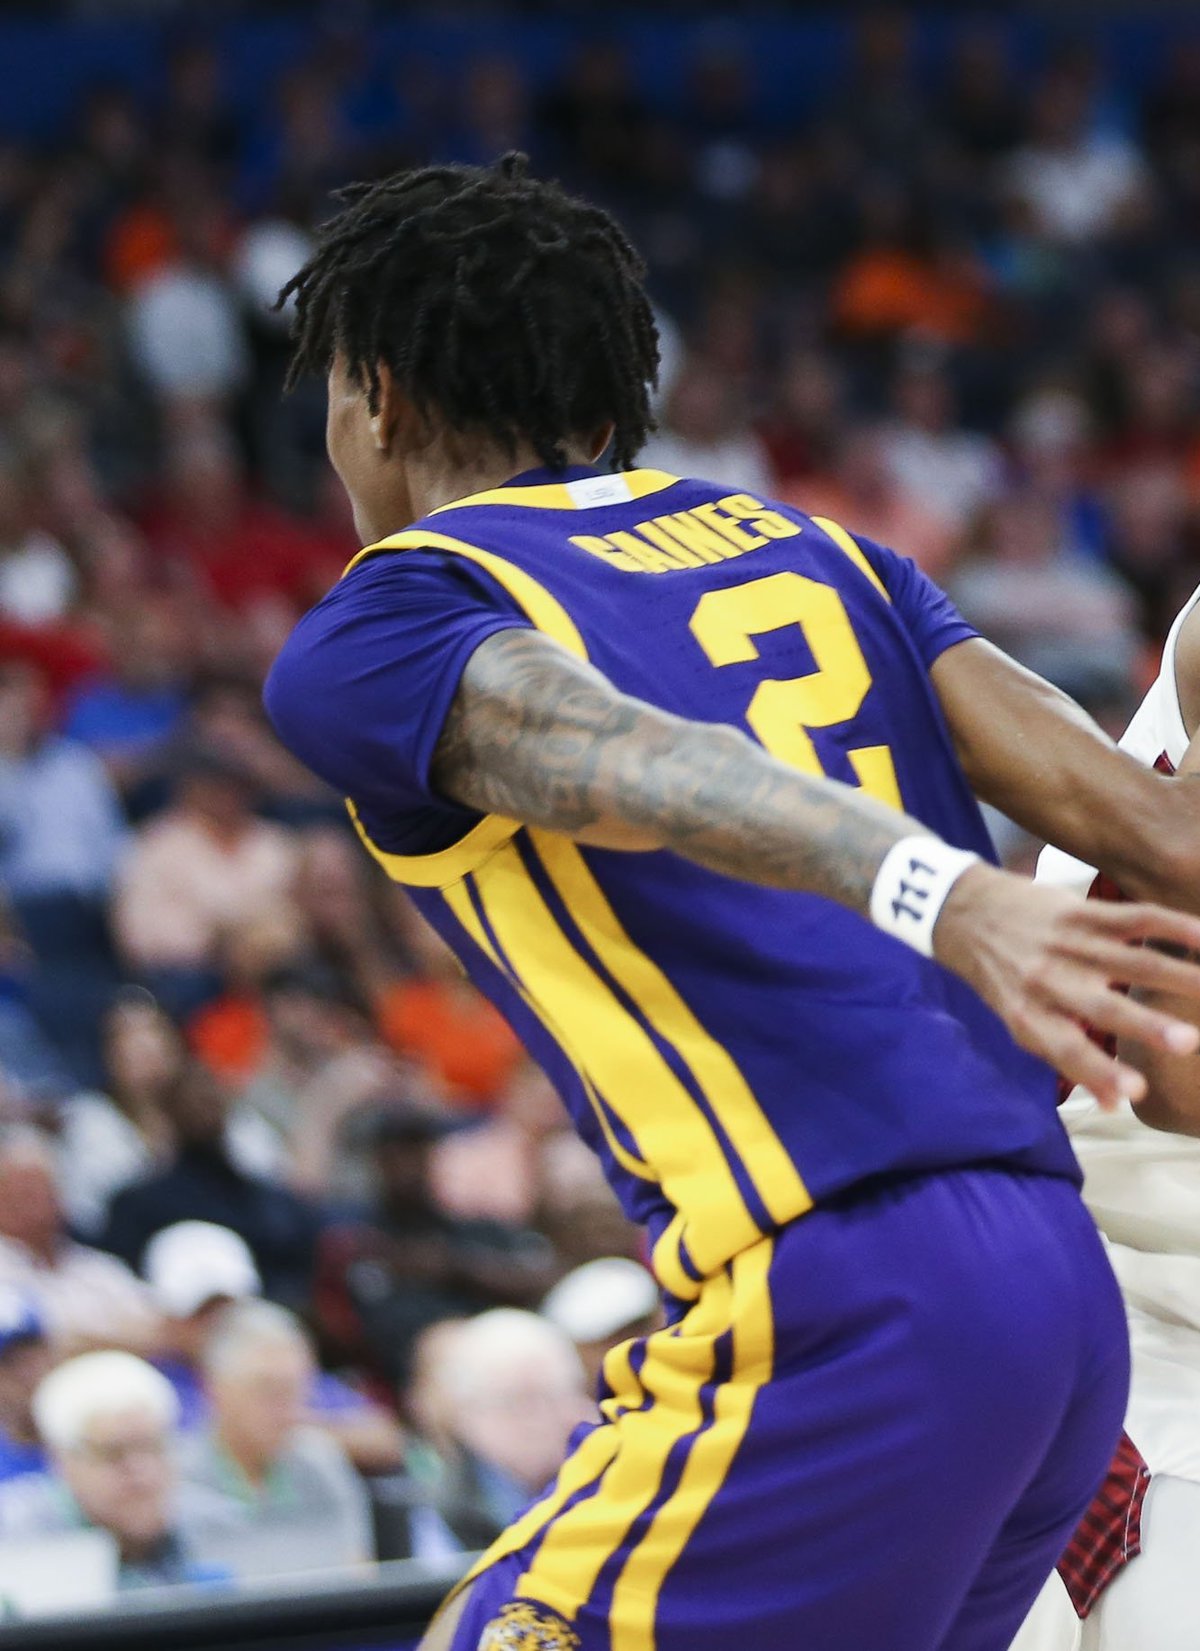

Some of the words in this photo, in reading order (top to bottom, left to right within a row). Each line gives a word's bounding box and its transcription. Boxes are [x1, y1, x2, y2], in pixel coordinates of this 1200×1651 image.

[568, 493, 803, 574] GAINES
[689, 571, 905, 811] 2
[891, 857, 937, 921] 111
